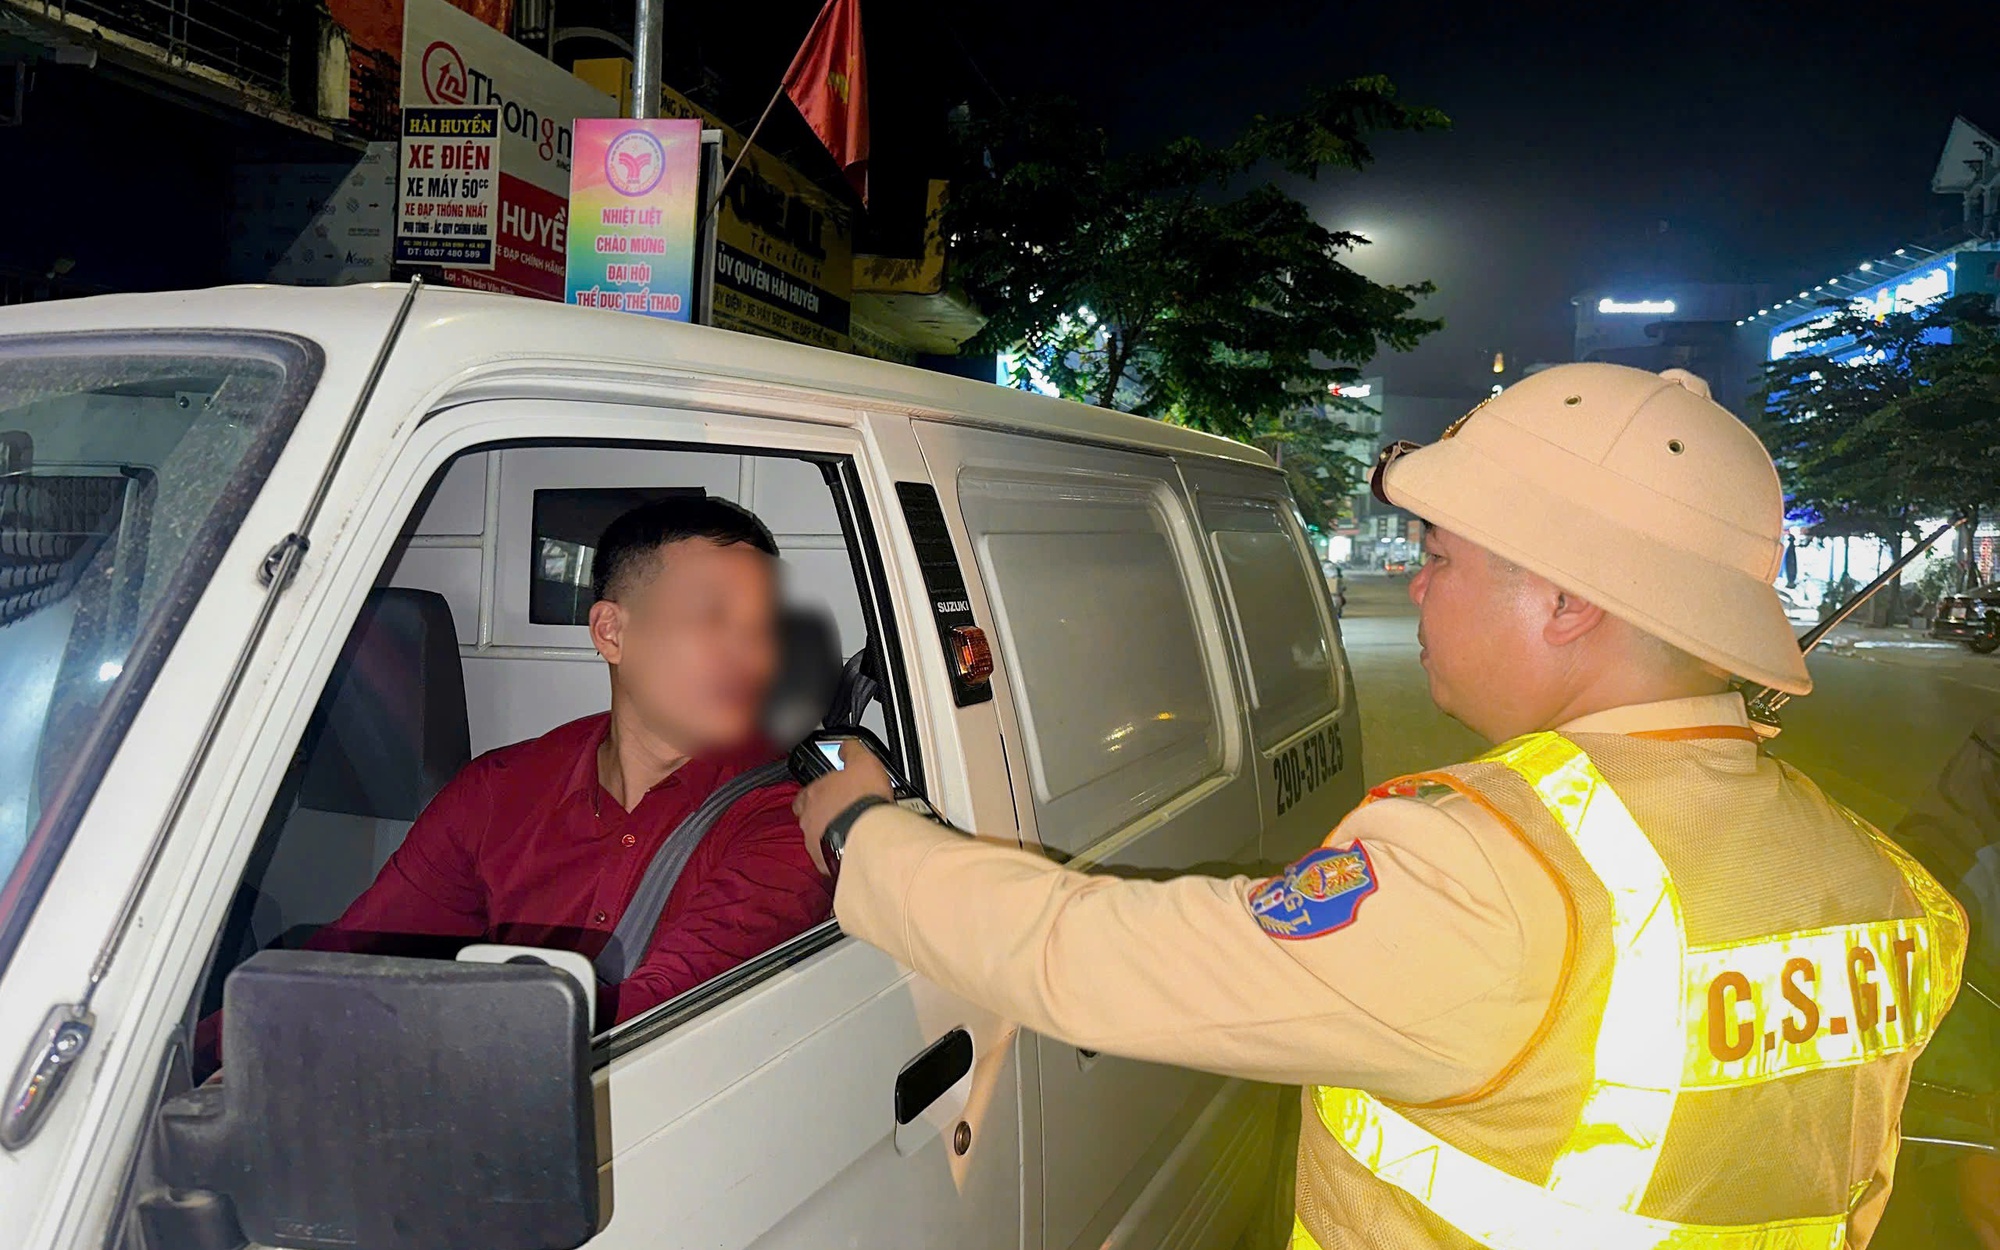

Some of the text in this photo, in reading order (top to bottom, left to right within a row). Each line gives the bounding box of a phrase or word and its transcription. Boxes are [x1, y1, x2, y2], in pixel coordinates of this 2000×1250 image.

[409, 113, 437, 133] HẢI
[468, 68, 571, 161] Thongn
[408, 144, 434, 169] XE
[441, 140, 490, 176] ĐIỆN
[406, 177, 424, 197] XE
[427, 174, 458, 198] MÁY
[405, 200, 488, 219] XE ĐẠP THỐNG NHẤT
[602, 206, 663, 228] NHIỆT LIỆT
[502, 201, 566, 254] HUYỀ
[424, 248, 444, 257] 0837
[596, 234, 665, 254] CHÀO MỪNG
[503, 246, 519, 263] ĐẠP
[520, 252, 545, 271] CHÍNH
[608, 262, 650, 285] ĐẠI HỘI
[577, 286, 599, 308] THỂ
[626, 288, 649, 310] THỂ
[650, 295, 680, 311] THAO
[937, 601, 969, 613] SUZUKI
